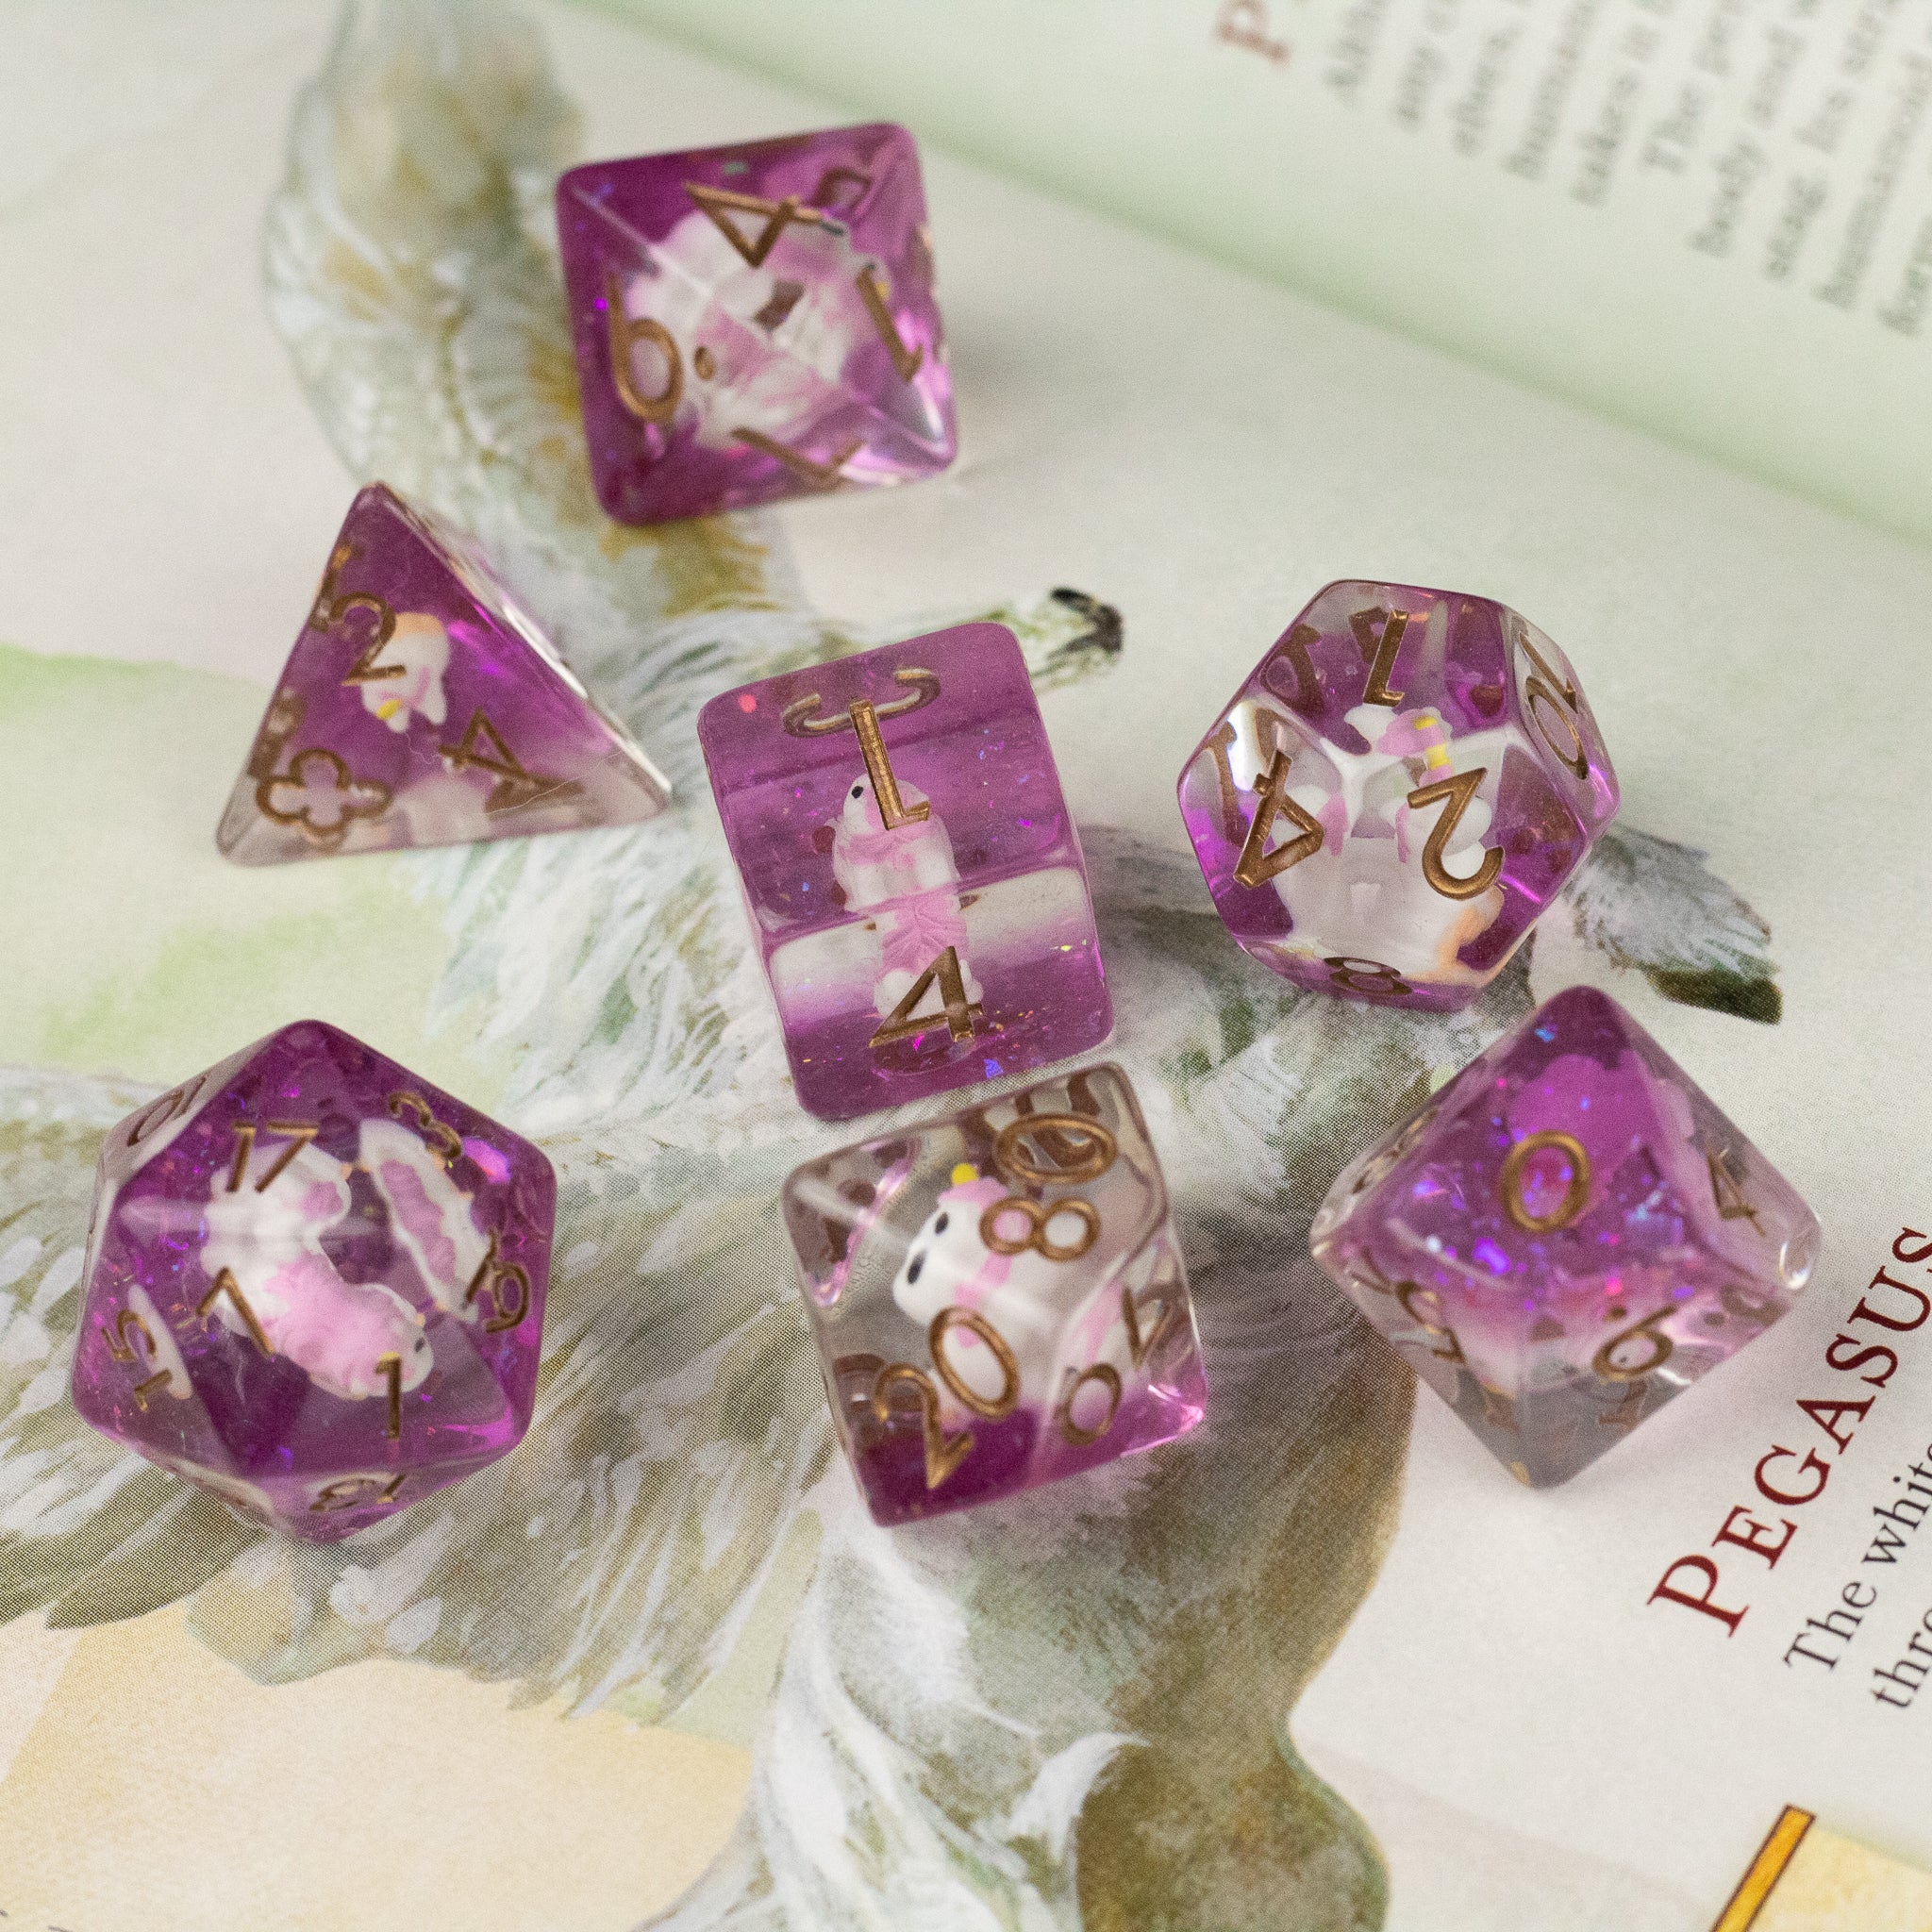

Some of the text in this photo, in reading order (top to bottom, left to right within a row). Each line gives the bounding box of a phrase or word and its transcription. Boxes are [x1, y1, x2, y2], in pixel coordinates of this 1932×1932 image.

[683, 182, 824, 268] 4
[330, 591, 407, 686] 2
[439, 708, 585, 796] 4
[1233, 750, 1324, 890] 4
[1407, 767, 1506, 901] 2
[870, 946, 984, 1048] 4
[228, 1121, 319, 1193] 17
[389, 1091, 463, 1158] 3
[1498, 1130, 1591, 1234] 0
[195, 1266, 275, 1357] 7
[375, 1354, 403, 1441] 1
[1645, 1226, 1932, 1638] PEGASUS
[1782, 1443, 1932, 1671] The whit
